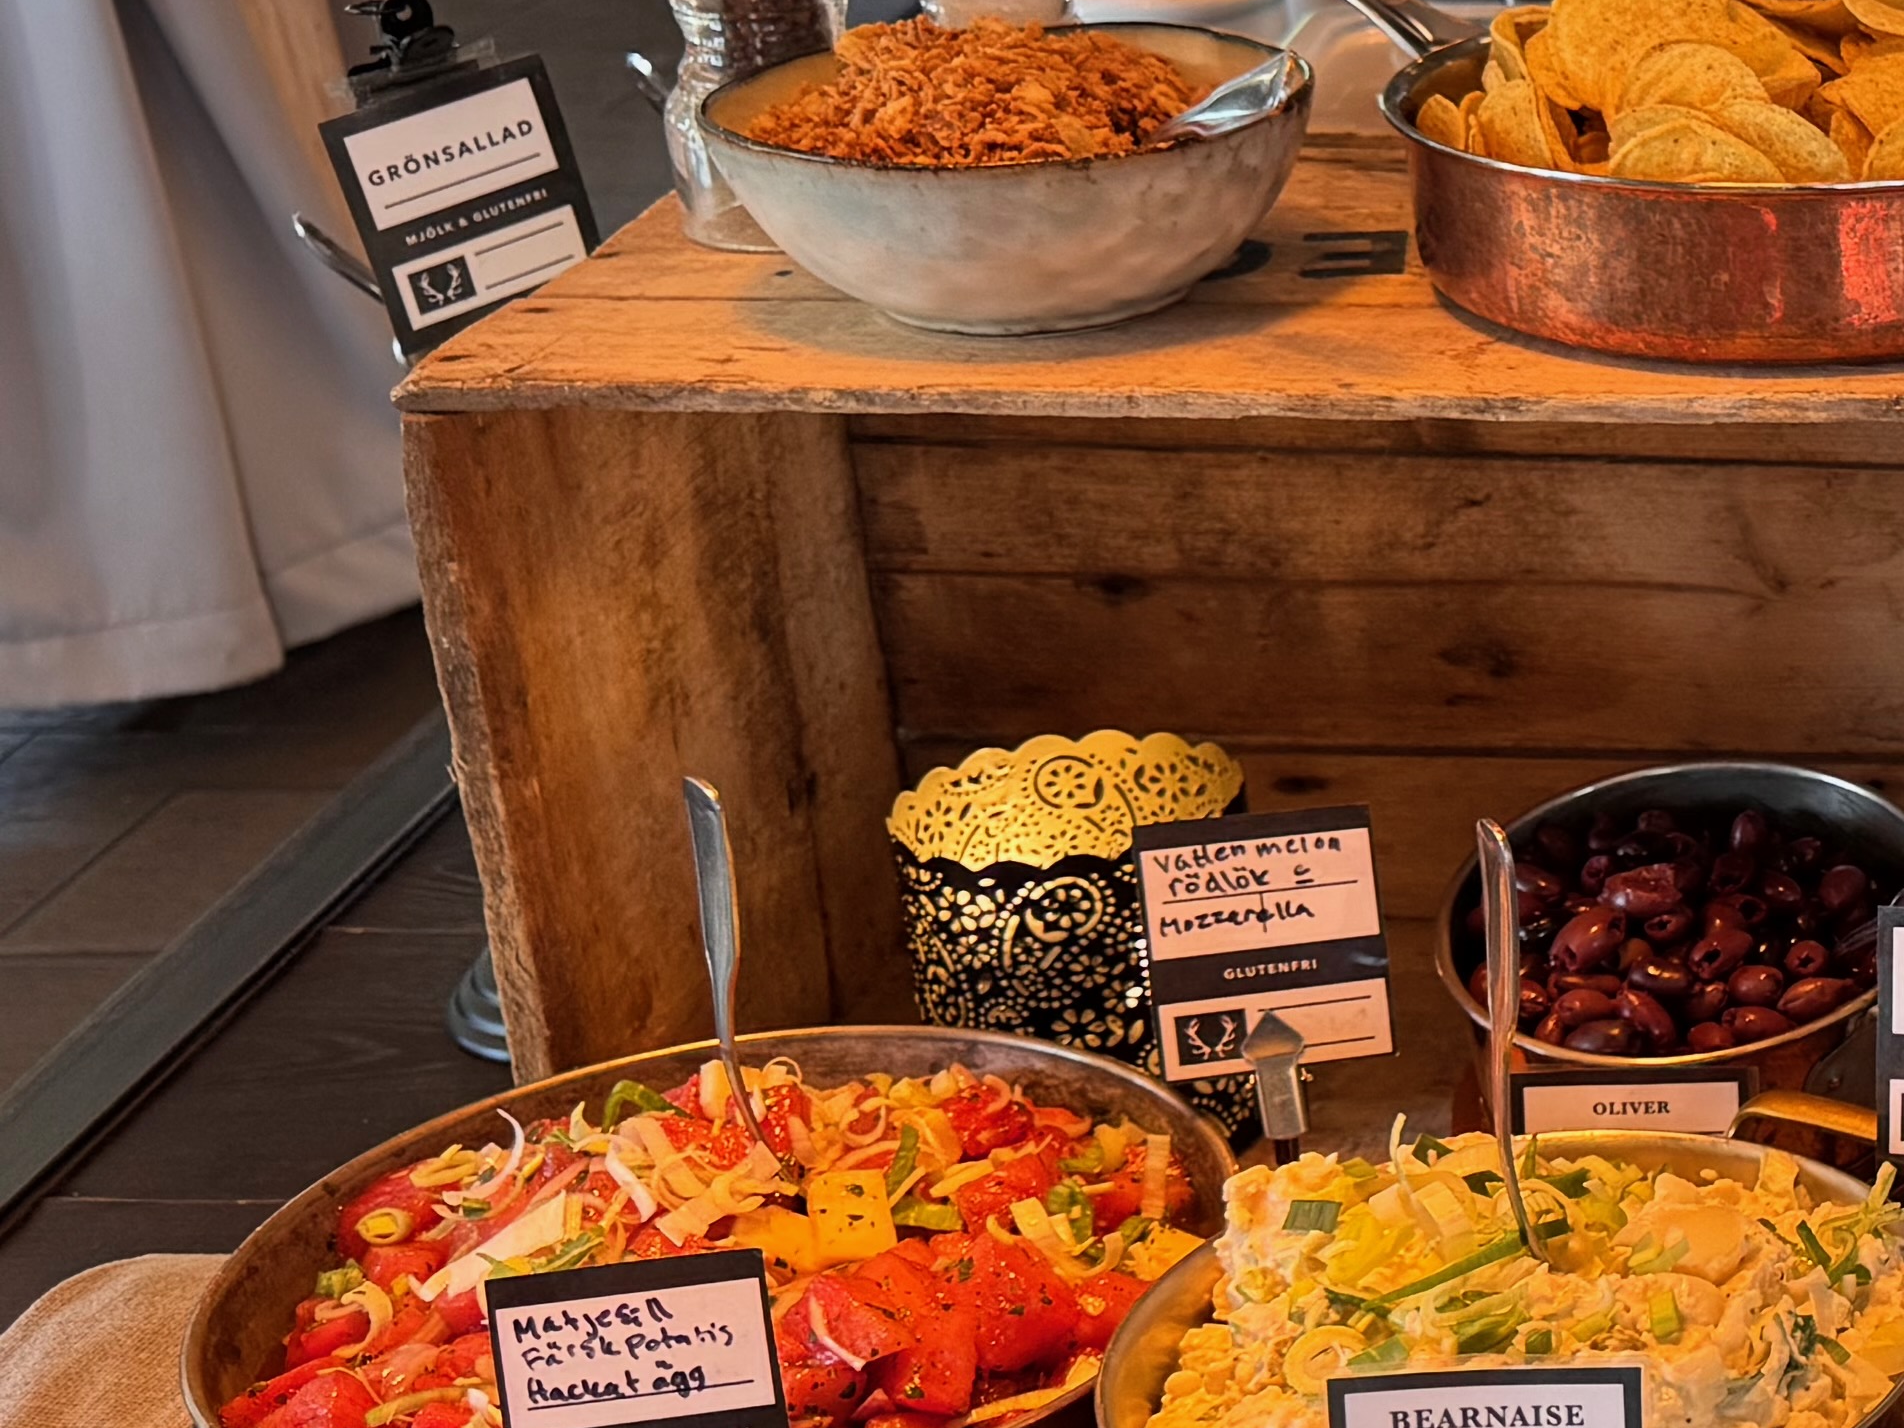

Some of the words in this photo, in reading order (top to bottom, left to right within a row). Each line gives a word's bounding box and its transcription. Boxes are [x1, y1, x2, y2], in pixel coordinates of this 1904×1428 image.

[368, 119, 533, 187] GRÖNSALLAD
[405, 222, 455, 245] MJÖLK
[472, 188, 548, 225] GLUTENFRI
[1224, 959, 1317, 980] GLUTENFRI
[1592, 1100, 1670, 1115] OLIVER
